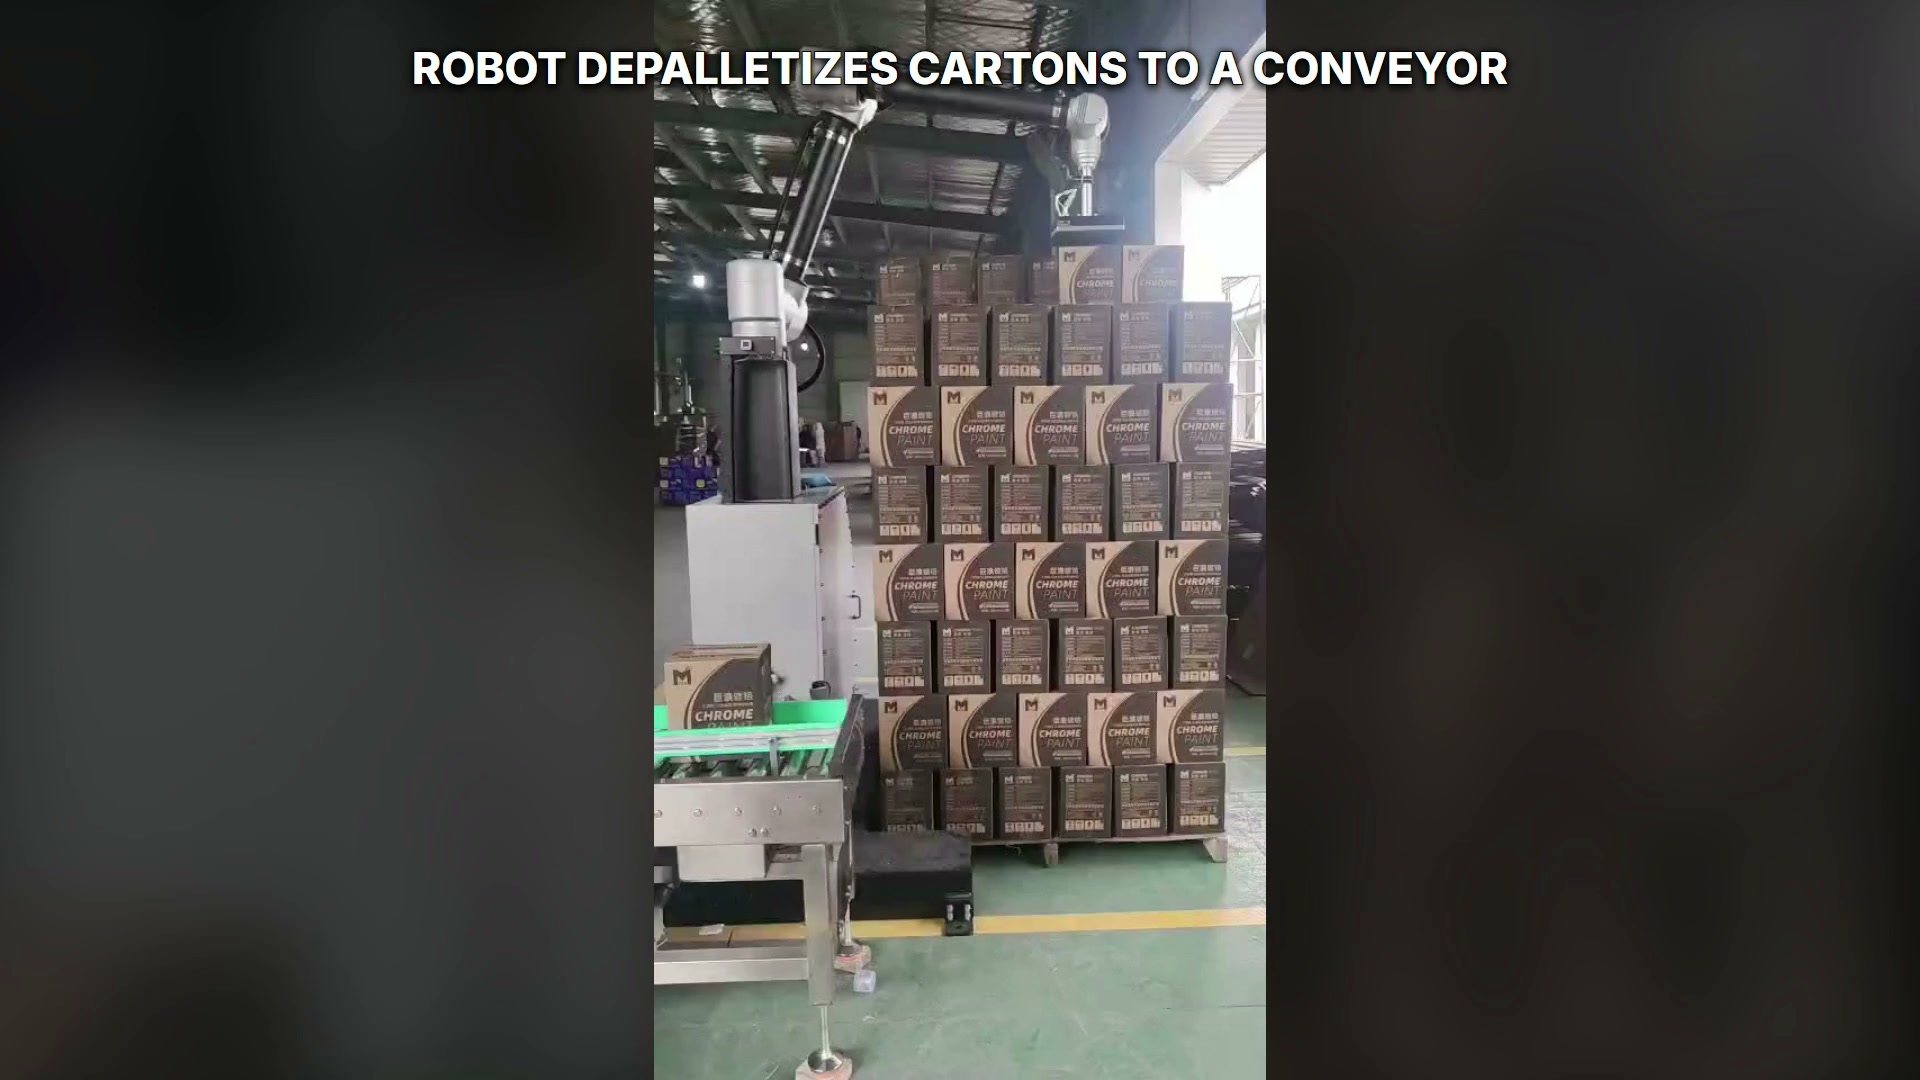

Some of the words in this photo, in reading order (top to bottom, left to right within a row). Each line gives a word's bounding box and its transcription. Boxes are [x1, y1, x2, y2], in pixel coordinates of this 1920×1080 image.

[889, 425, 933, 434] CHROME
[962, 424, 1005, 433] CHROME
[1035, 424, 1078, 433] CHROME
[1106, 423, 1149, 432] CHROME
[1182, 423, 1226, 431] CHROME
[895, 581, 938, 590] CHROME
[965, 580, 1008, 589] CHROME
[1036, 580, 1078, 588] CHROME
[1106, 578, 1149, 587] CHROME
[1178, 577, 1221, 585] CHROME
[673, 669, 691, 685] M
[695, 709, 753, 721] CHROME
[969, 730, 1011, 738] CHROME
[1039, 729, 1080, 737] CHROME
[1108, 728, 1149, 737] CHROME
[1177, 725, 1218, 734] CHROME
[900, 732, 941, 740] CHROME
